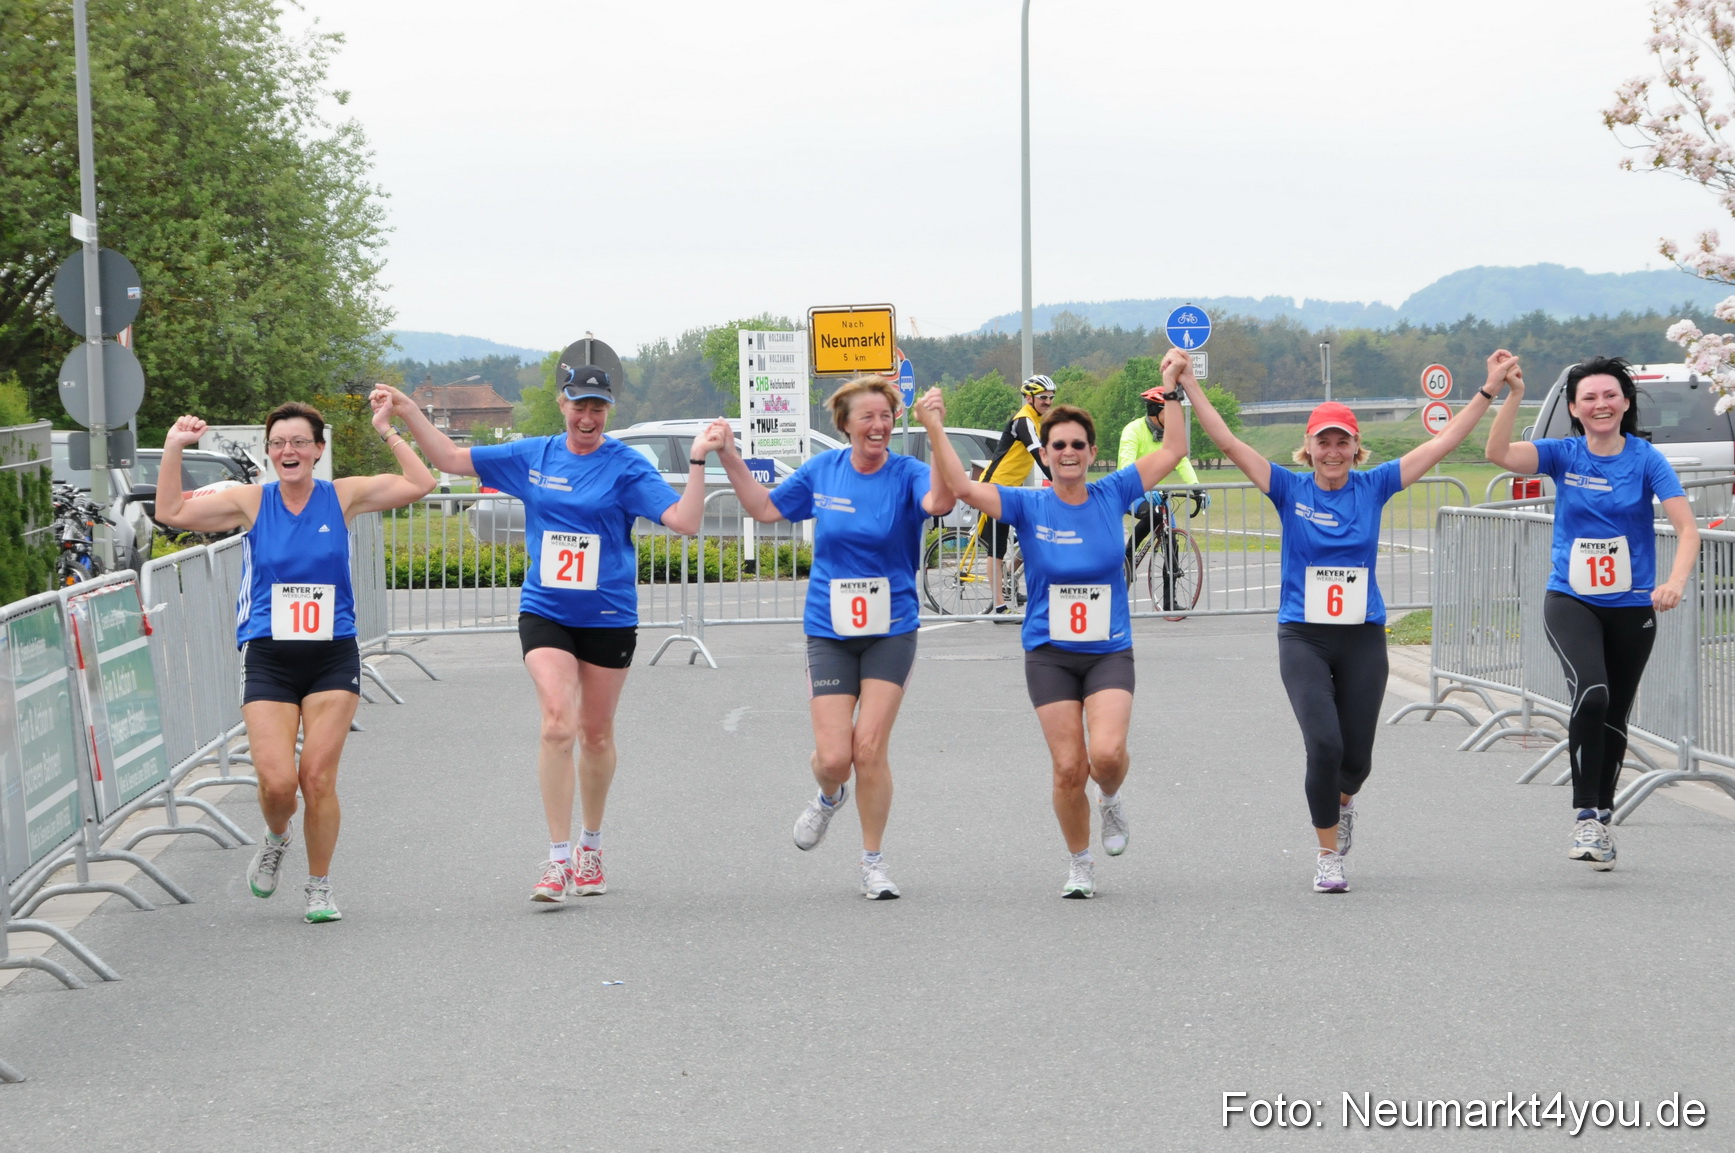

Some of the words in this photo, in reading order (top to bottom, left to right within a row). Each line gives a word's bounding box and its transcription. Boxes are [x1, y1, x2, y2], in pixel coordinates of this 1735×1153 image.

[842, 320, 864, 328] Nach
[821, 332, 885, 348] Neumarkt
[843, 354, 848, 362] 5
[1429, 374, 1445, 390] 60
[756, 418, 779, 434] THULE
[557, 550, 585, 582] 21
[1586, 556, 1616, 587] 13
[1327, 585, 1343, 616] 6
[290, 601, 320, 633] 10
[852, 597, 867, 628] 9
[1070, 602, 1087, 634] 8
[813, 679, 840, 688] ODLO
